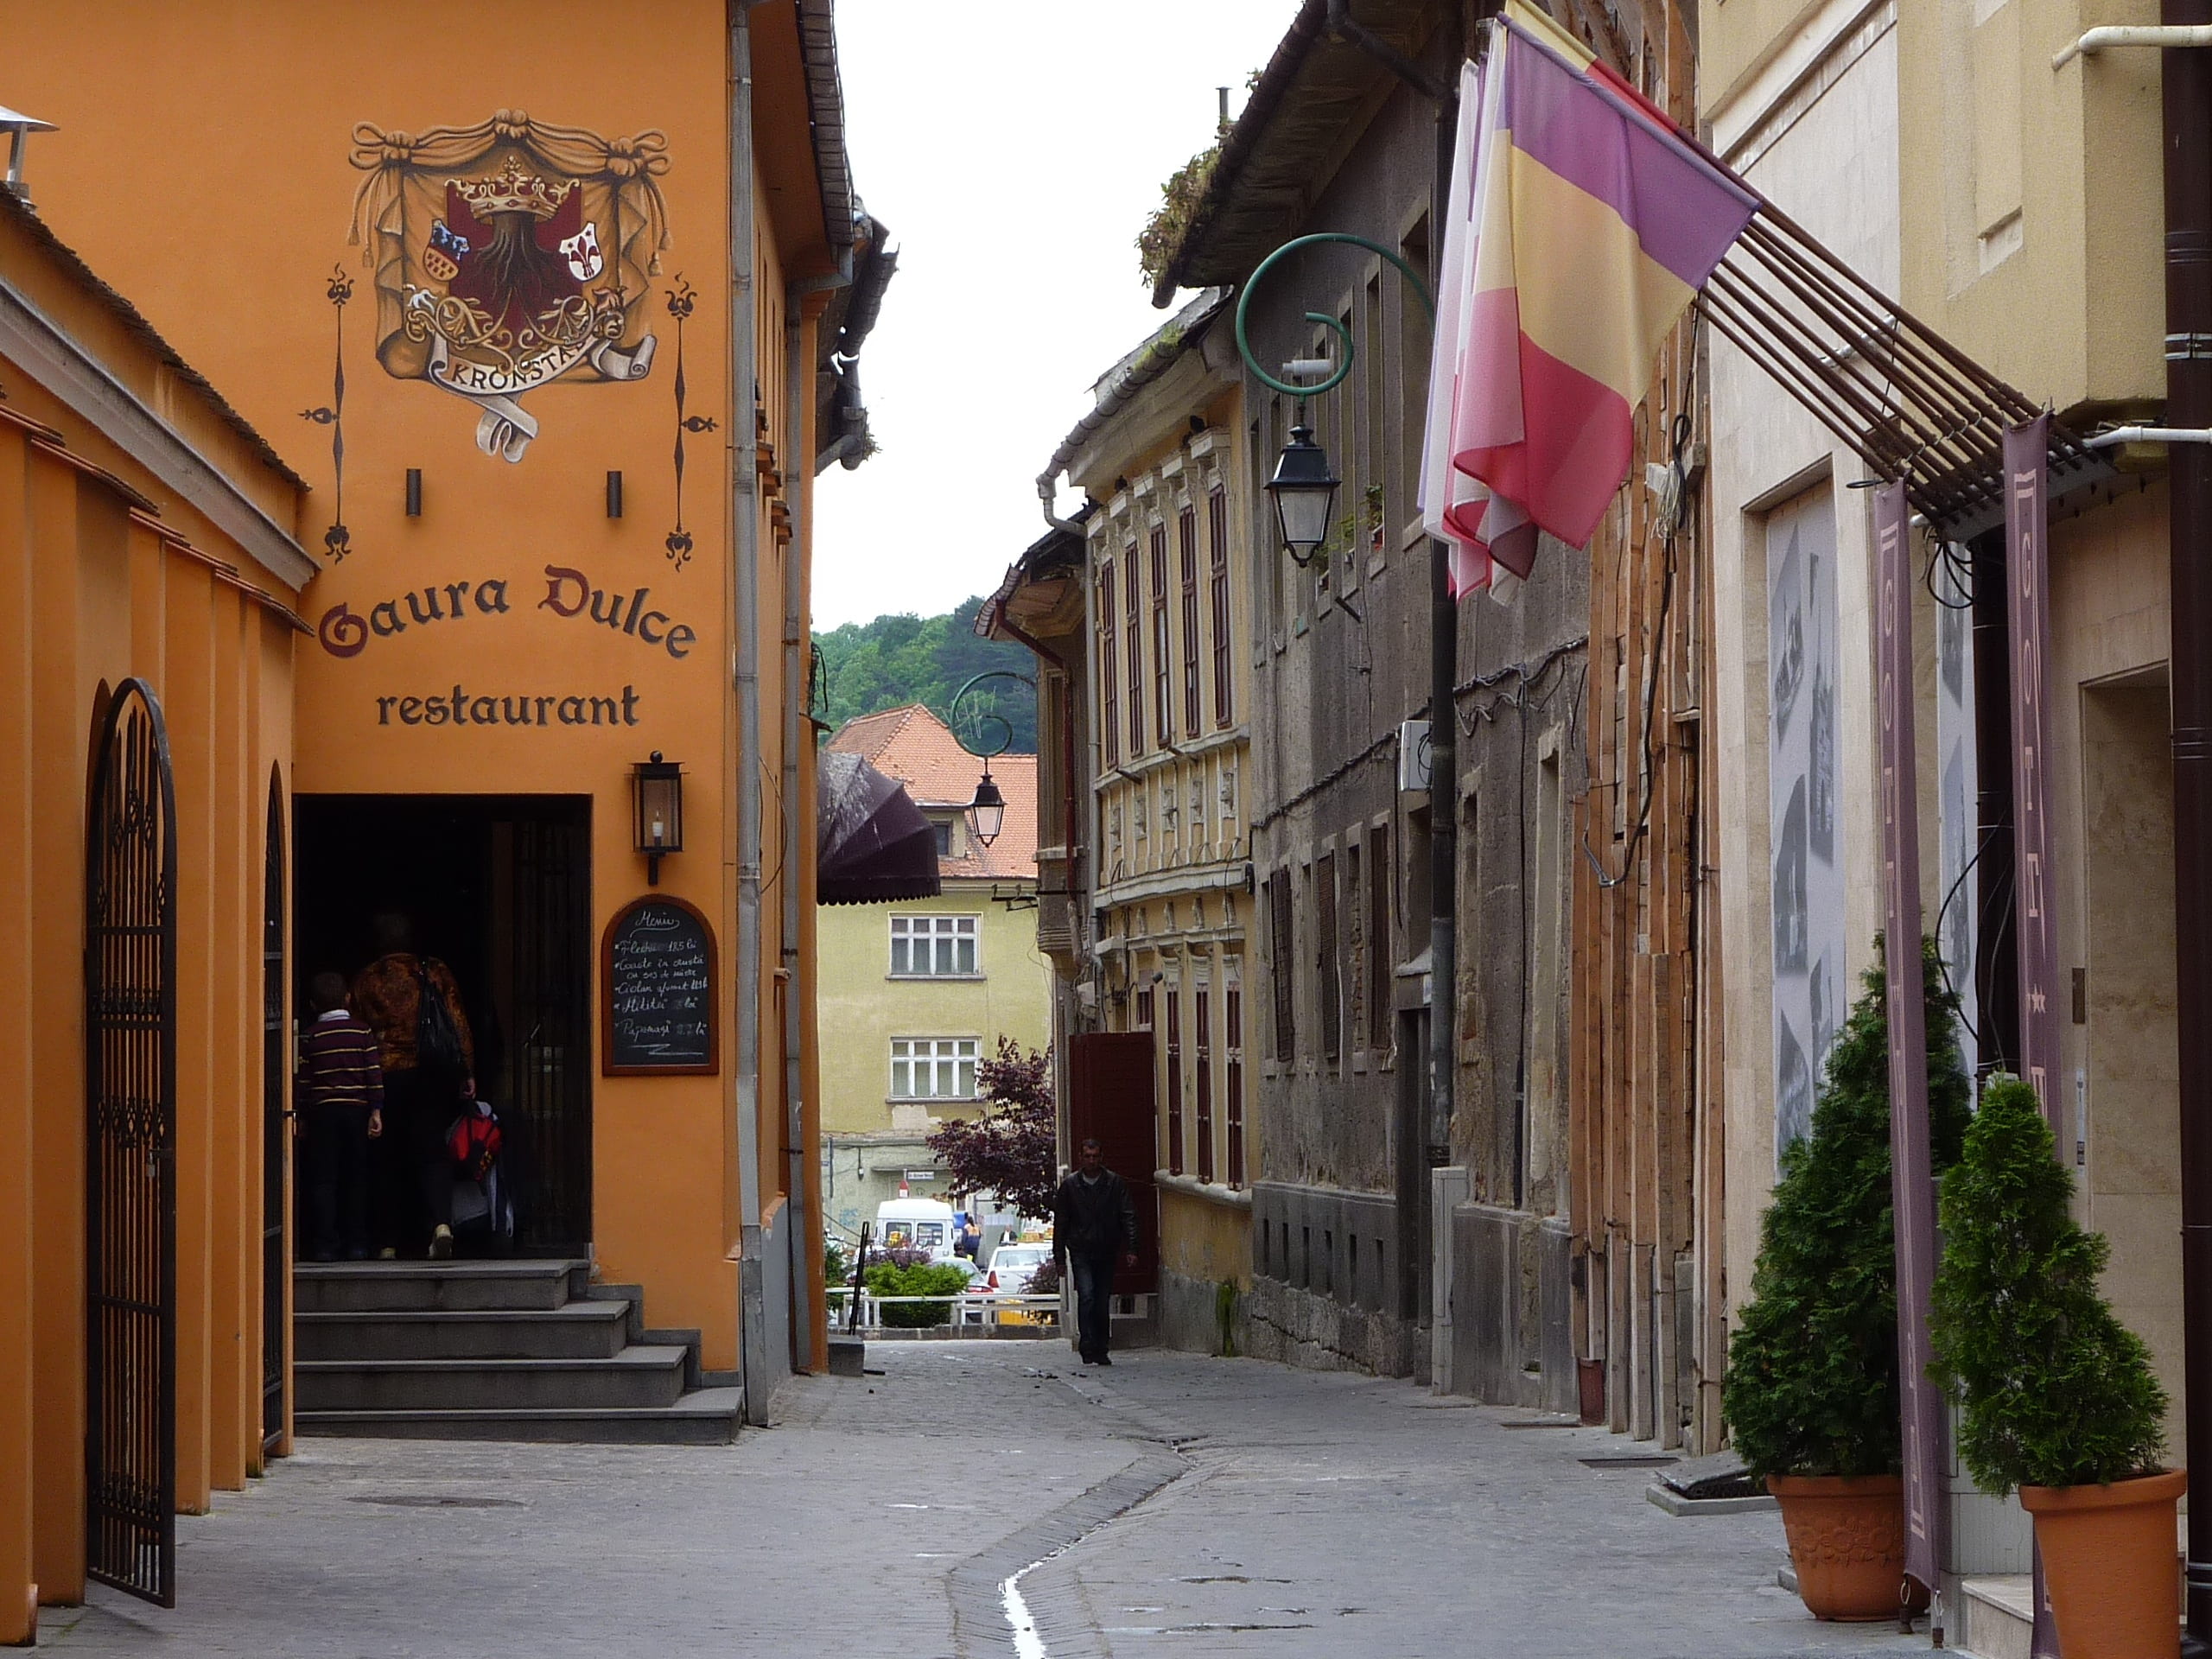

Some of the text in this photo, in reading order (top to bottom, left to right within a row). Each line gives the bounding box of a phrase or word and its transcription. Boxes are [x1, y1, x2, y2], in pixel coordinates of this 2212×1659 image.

[318, 563, 697, 659] Gaura Dulce
[376, 683, 640, 727] restaurant
